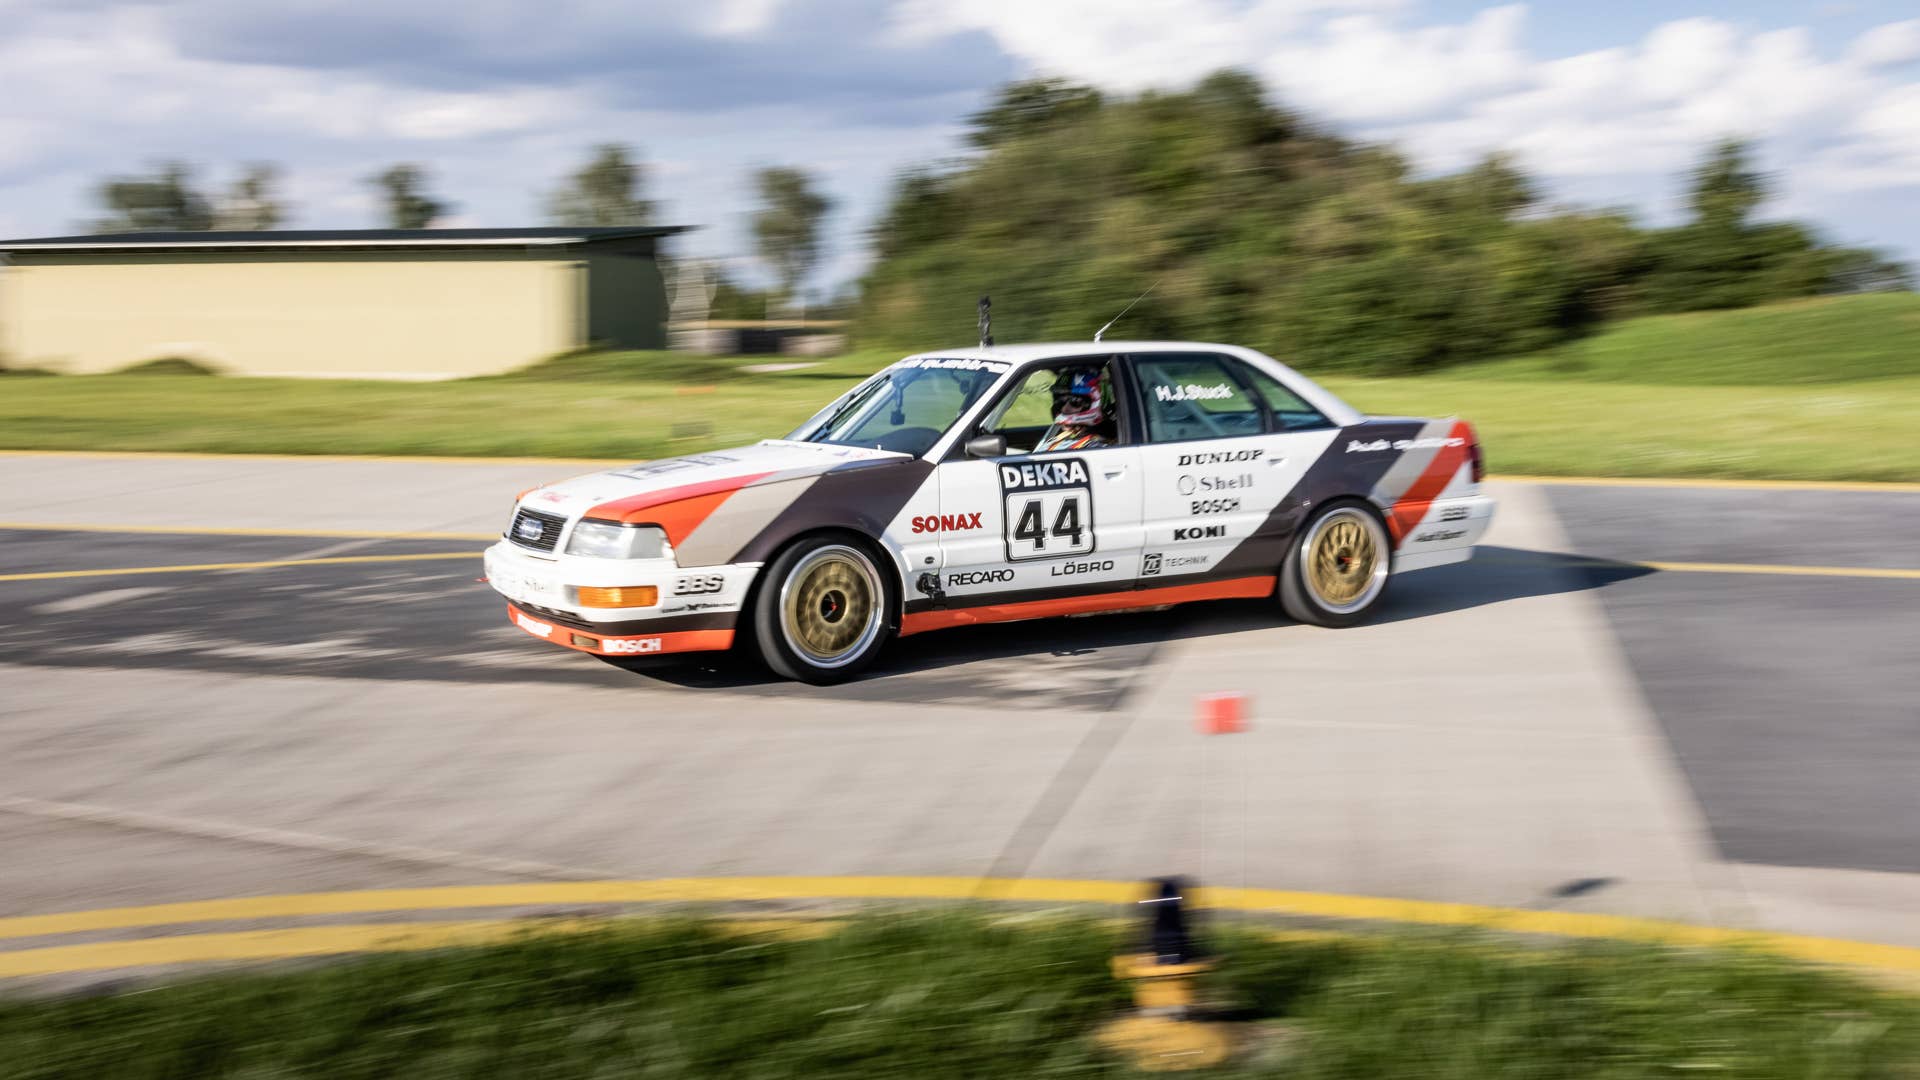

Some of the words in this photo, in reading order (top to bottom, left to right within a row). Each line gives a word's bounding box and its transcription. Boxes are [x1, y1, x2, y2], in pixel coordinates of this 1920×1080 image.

[1155, 383, 1234, 402] H.J.Stuck
[1178, 449, 1264, 466] DUNLOP
[1002, 462, 1087, 489] DEKRA
[1200, 474, 1253, 491] Shell
[1191, 498, 1240, 515] BOSCH
[911, 512, 983, 534] SONAX
[1014, 497, 1083, 550] 44
[1173, 525, 1226, 541] KONI
[1051, 560, 1114, 577] LÖBRO
[674, 574, 724, 596] BBS
[948, 569, 1015, 587] RECARO
[602, 637, 662, 653] BOSCH
